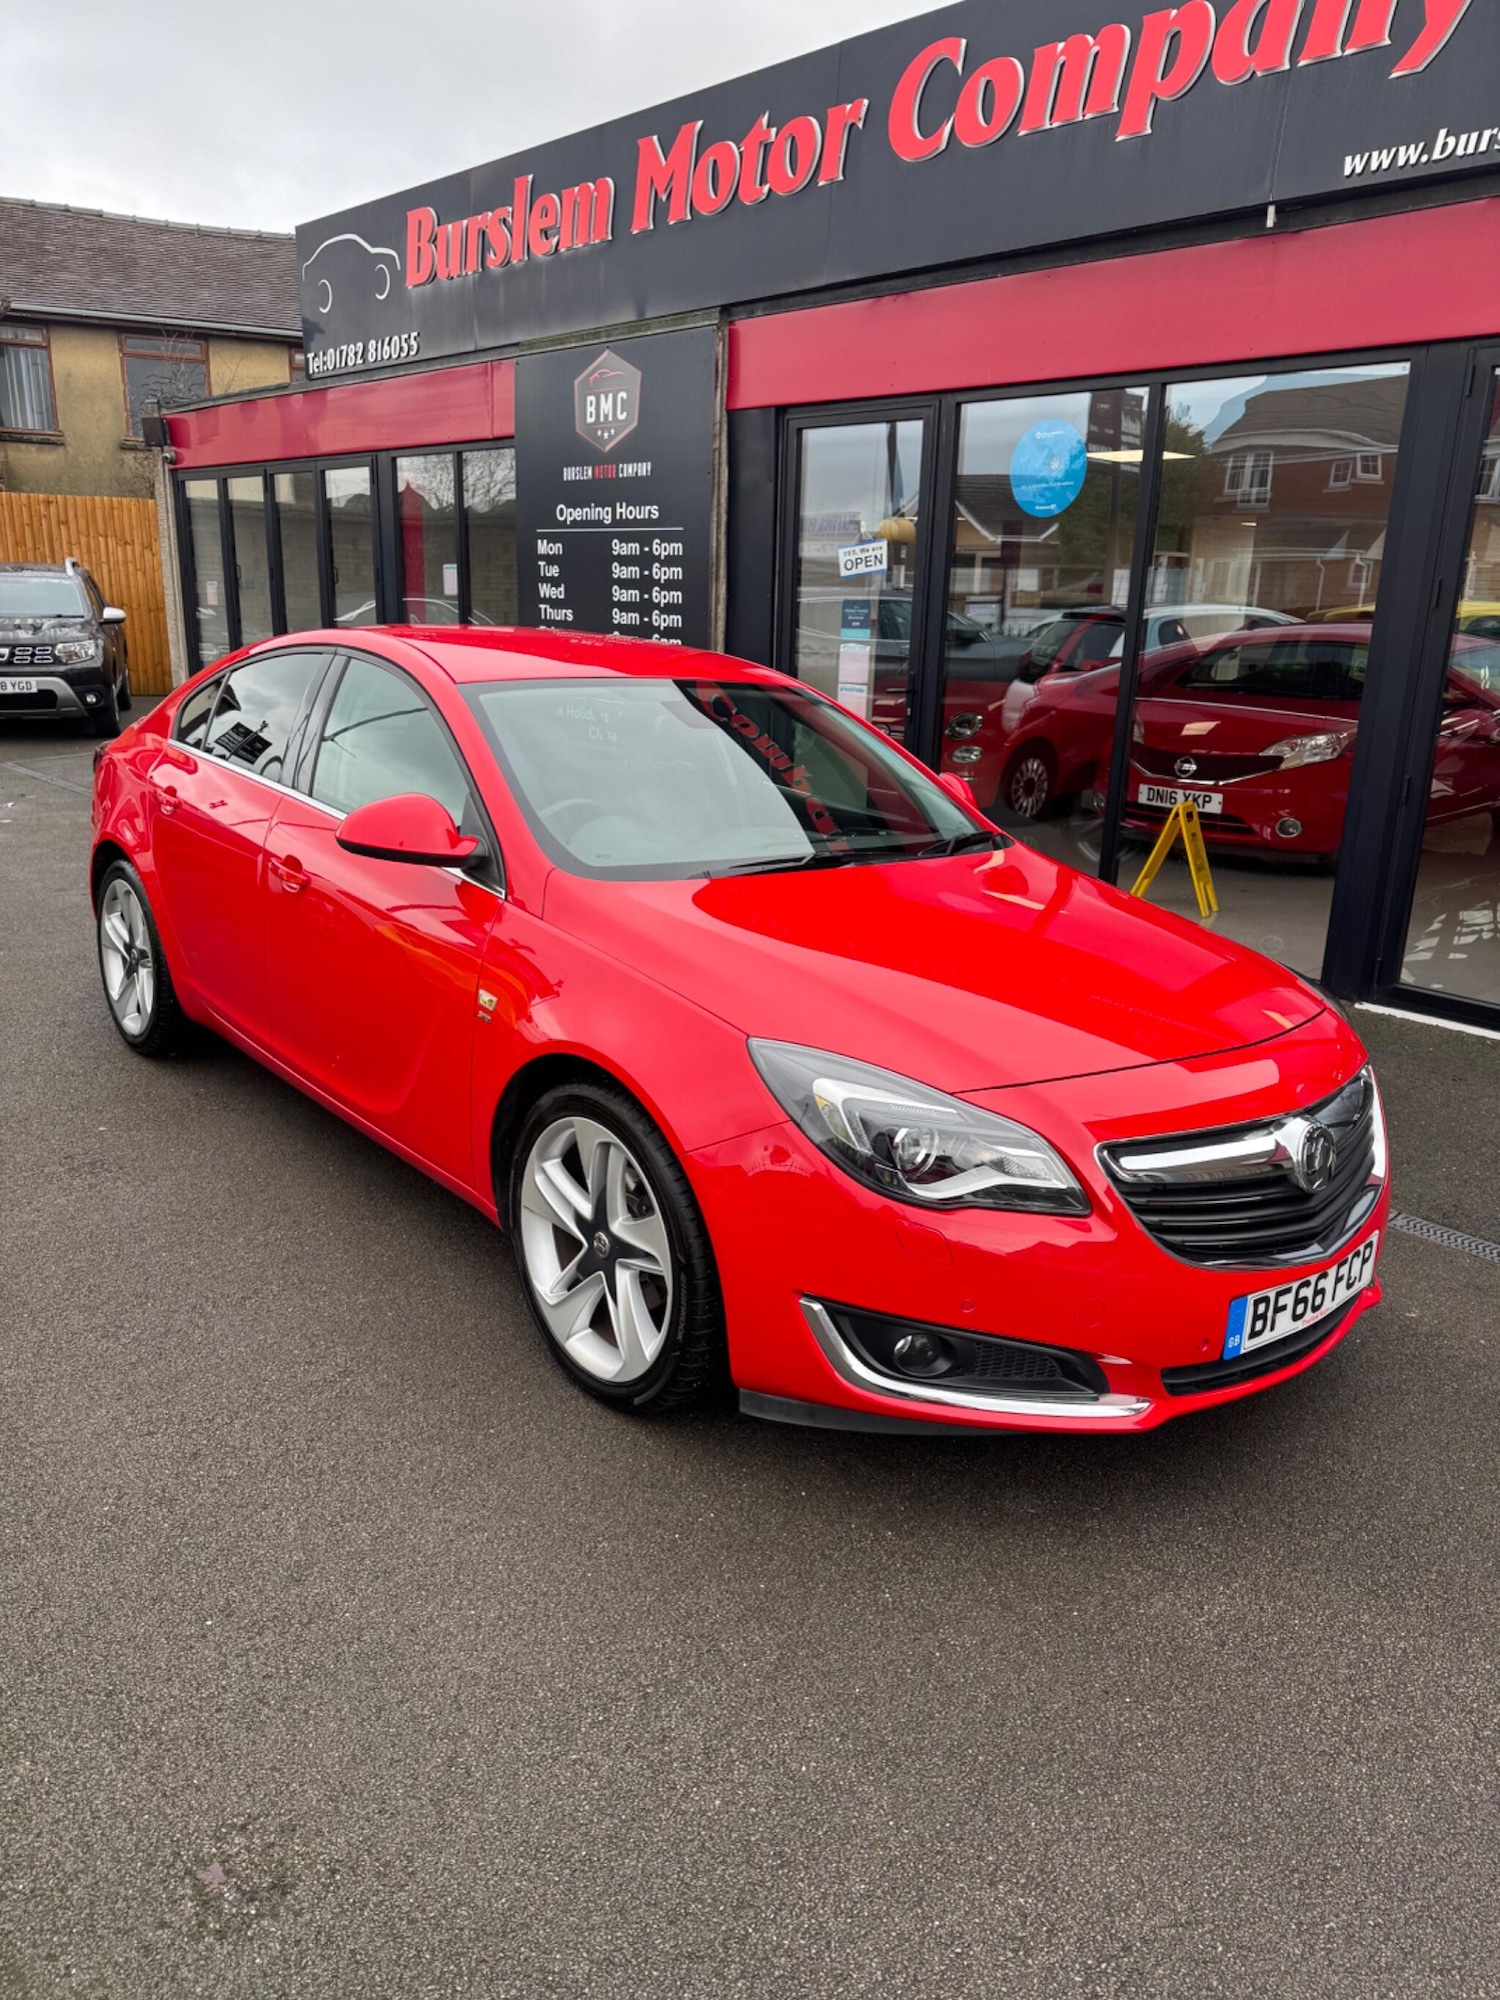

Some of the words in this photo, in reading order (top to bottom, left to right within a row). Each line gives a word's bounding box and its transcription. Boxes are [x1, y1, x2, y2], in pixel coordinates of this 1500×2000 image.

[404, 173, 615, 290] Burslem
[631, 98, 870, 234] Motor
[888, 0, 1473, 162] Company
[307, 341, 365, 374] Tel:01782
[368, 331, 419, 363] 816055
[586, 391, 628, 424] BMC
[556, 502, 612, 525] Opening
[616, 501, 660, 520] Hours
[537, 538, 563, 556] Mon
[612, 538, 640, 556] 9am
[652, 538, 683, 560] 6pm
[538, 560, 560, 577] Tue
[612, 562, 640, 579] 9am
[652, 562, 683, 584] 6pm
[844, 553, 883, 571] OPEN
[538, 582, 565, 600] Wed
[612, 584, 640, 602] 9am
[652, 585, 683, 608] 6pm
[538, 603, 574, 622] Thurs
[612, 607, 640, 625] 9am
[652, 608, 683, 630] 6pm
[1147, 787, 1177, 805] DN16
[1182, 790, 1213, 809] YKP
[1247, 1270, 1329, 1341] BF66
[1330, 1240, 1375, 1303] FCP
[1228, 1334, 1241, 1348] GB
